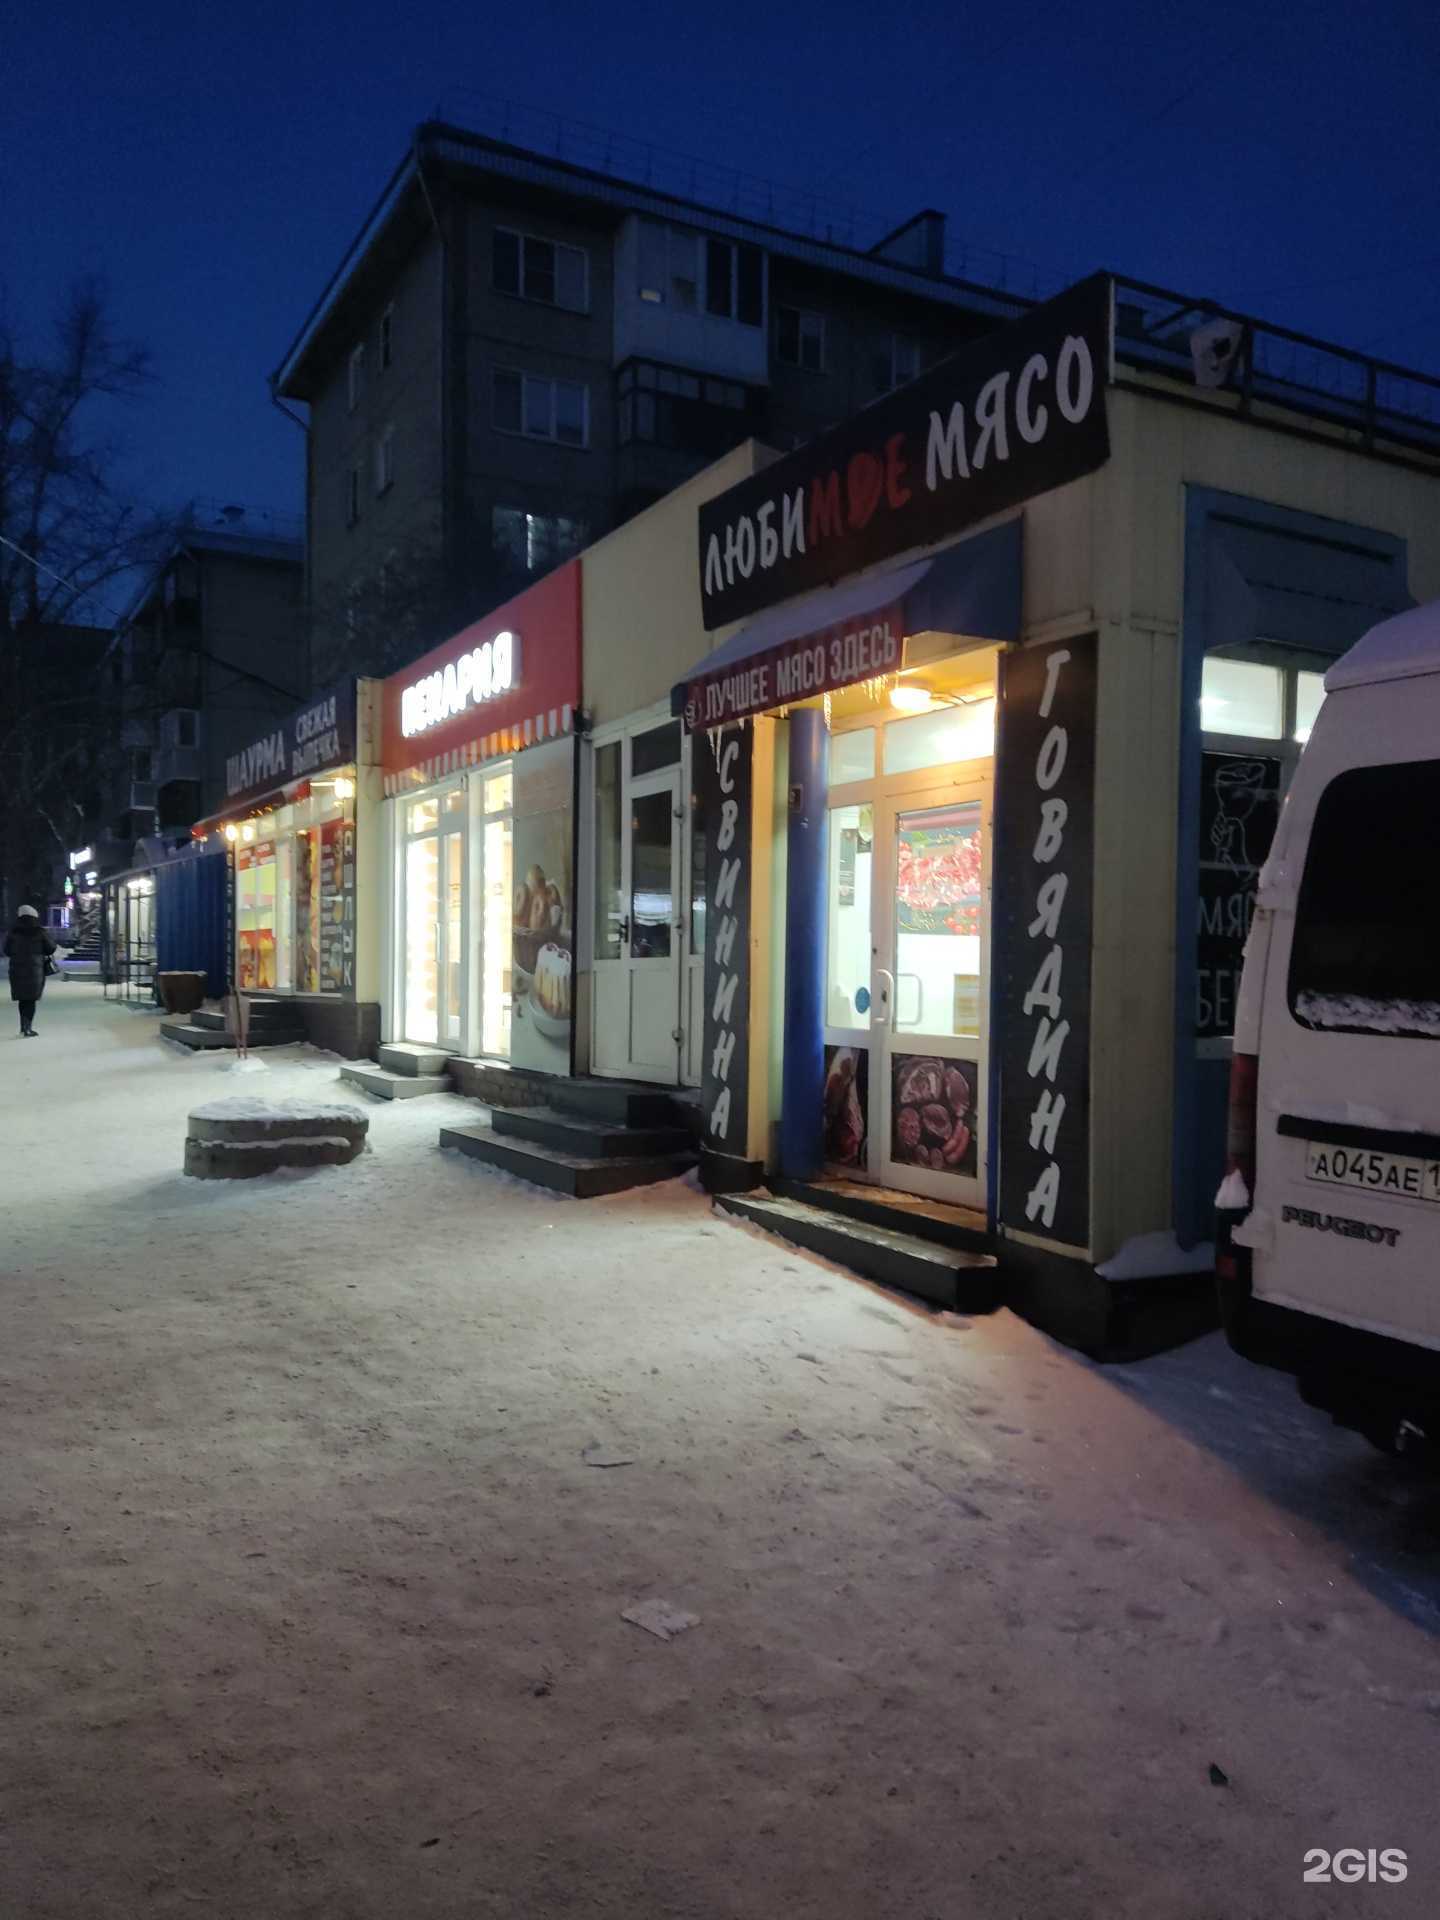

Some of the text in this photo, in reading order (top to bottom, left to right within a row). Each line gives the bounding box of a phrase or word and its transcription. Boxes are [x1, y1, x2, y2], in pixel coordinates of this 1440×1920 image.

[704, 335, 1094, 596] ЛЮБИМОЕ МЯСО
[704, 622, 898, 721] ЛУЧШЕЕ МЯСО ЗДЕСЬ
[292, 727, 341, 776] ВЫПЕЧКА
[295, 695, 336, 744] СВЕЖАЯ
[226, 730, 286, 796] ШАУРМА
[711, 740, 742, 1140] СВИНИНА
[1023, 650, 1071, 1229] ГОВЯДИНА
[1281, 1205, 1401, 1247] PEUGEOT
